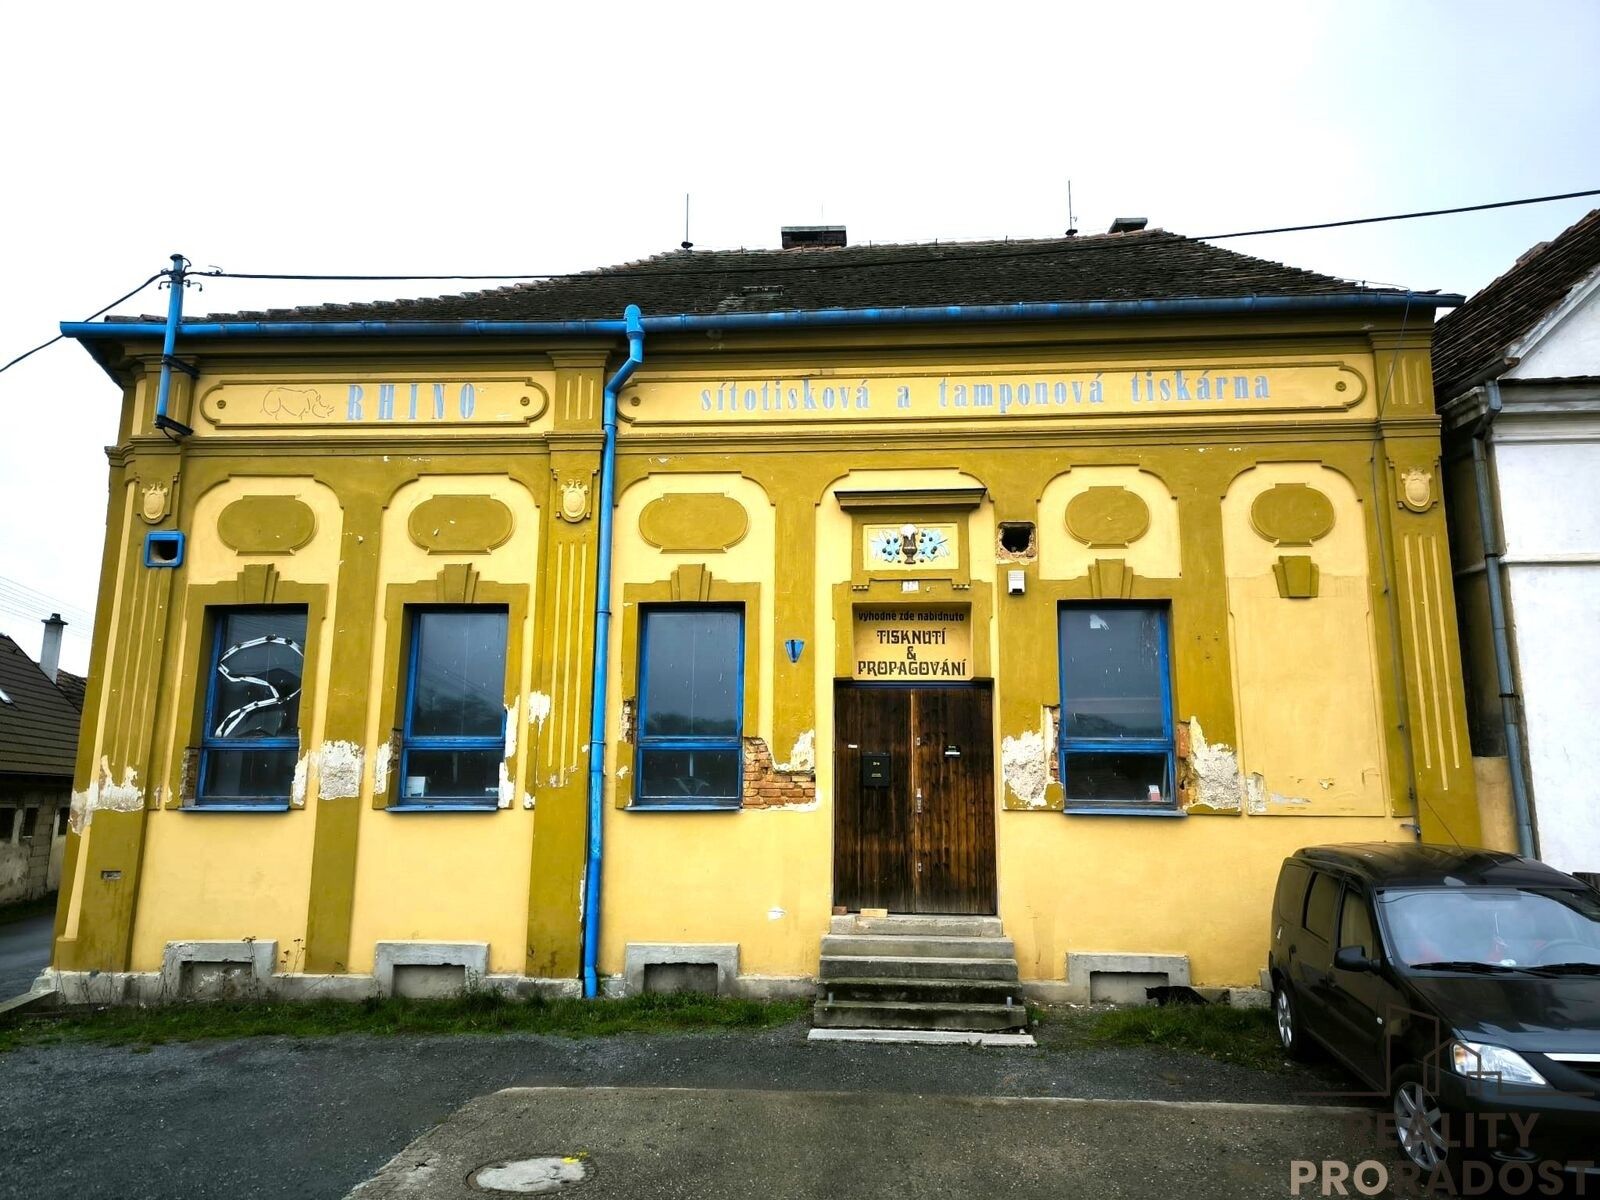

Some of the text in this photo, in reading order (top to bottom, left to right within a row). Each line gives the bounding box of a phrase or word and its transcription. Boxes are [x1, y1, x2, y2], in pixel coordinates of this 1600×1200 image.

[701, 369, 1270, 413] sítotisková a tamponová tiskárna
[346, 383, 475, 420] RHINO
[877, 627, 946, 645] TISKNUTÍ
[907, 646, 916, 660] &
[858, 658, 966, 677] PROPAGOVÁNÍ
